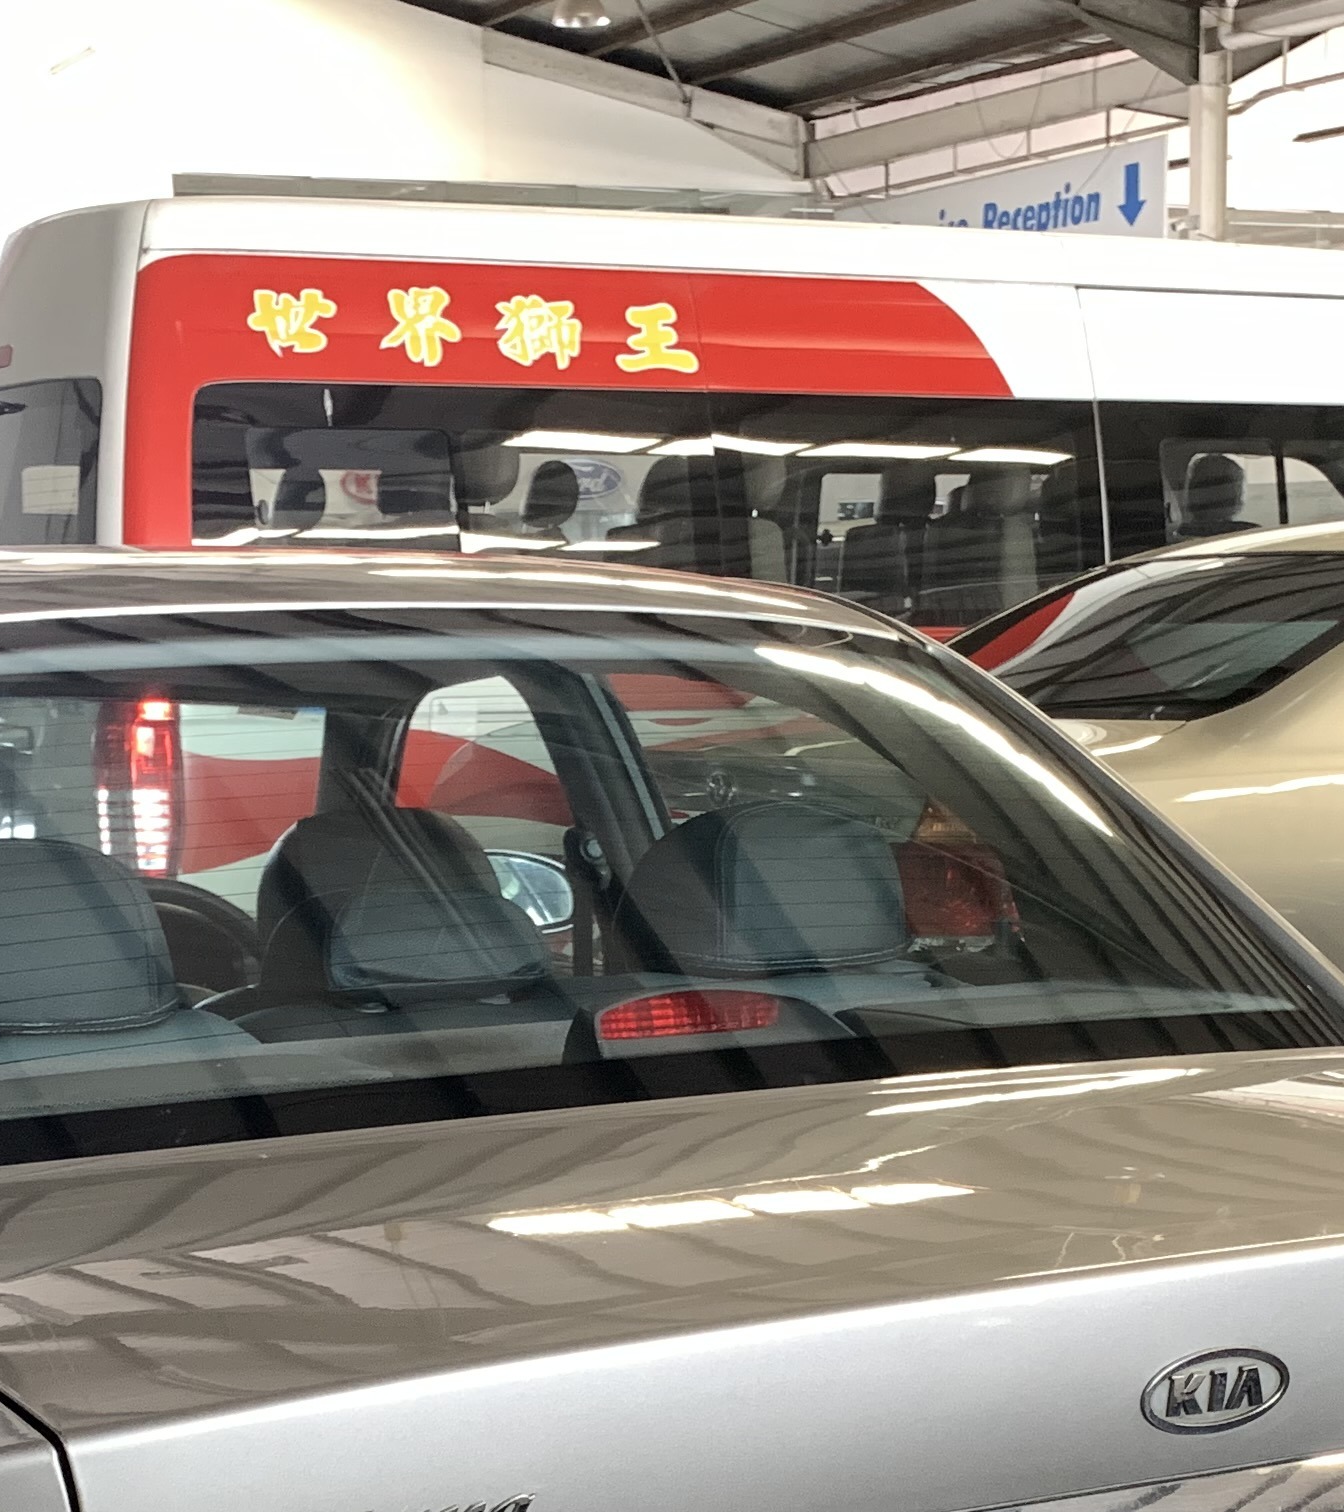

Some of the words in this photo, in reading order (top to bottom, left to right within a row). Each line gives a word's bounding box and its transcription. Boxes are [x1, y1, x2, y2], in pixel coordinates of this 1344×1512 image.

[982, 181, 1102, 232] Reception
[247, 286, 699, 373] 世界獅王
[1165, 1364, 1264, 1418] KIA
